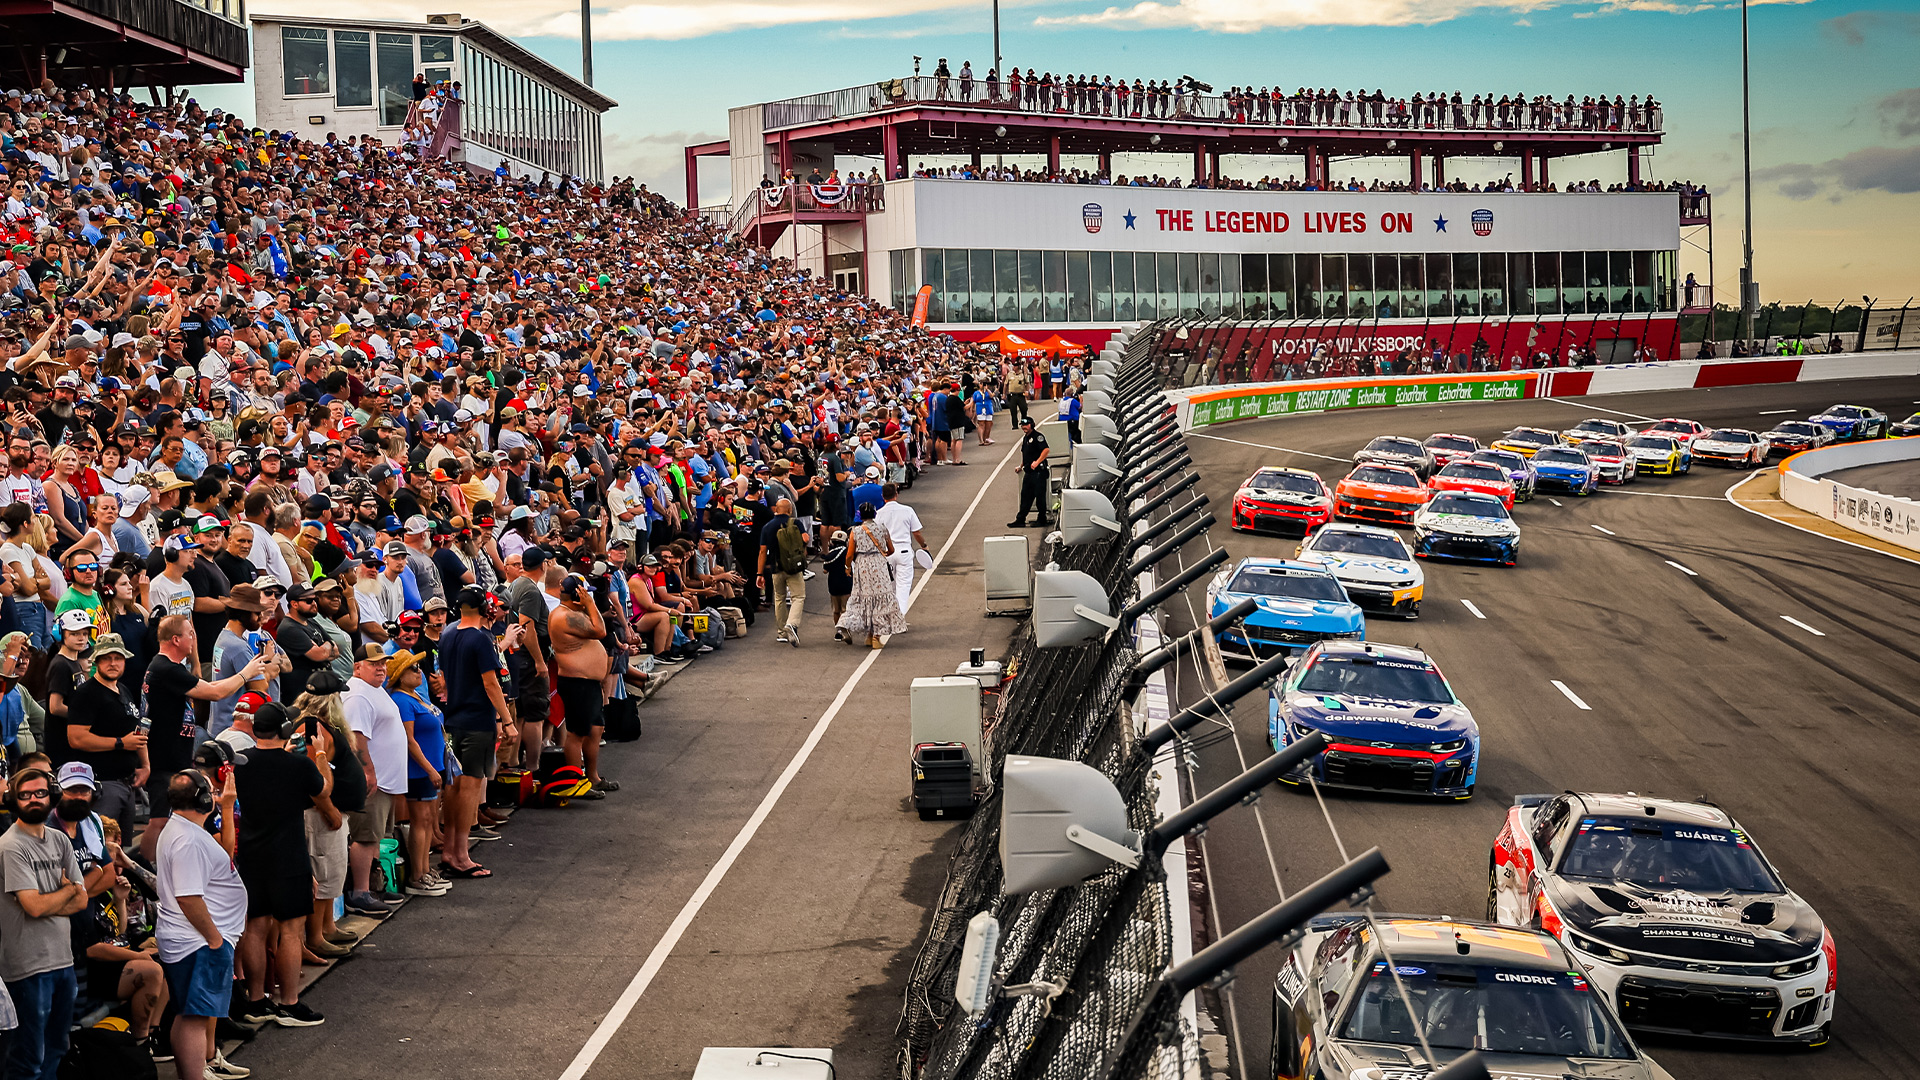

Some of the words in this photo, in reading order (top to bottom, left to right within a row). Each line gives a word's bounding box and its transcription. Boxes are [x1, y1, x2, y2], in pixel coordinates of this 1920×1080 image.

[1156, 209, 1193, 231] THE
[1206, 210, 1290, 233] LEGEND
[1304, 211, 1367, 233] LIVES
[1381, 212, 1413, 233] ON
[1295, 390, 1330, 410] RESTART
[1329, 388, 1353, 408] ZONE
[1356, 386, 1387, 406] EchoPark
[1395, 384, 1428, 404] EchoPark
[1437, 382, 1473, 402] EchoPark
[1483, 381, 1519, 399] EchoPark
[1376, 660, 1425, 671] MCDOWELL
[1324, 714, 1439, 731] delawarelife.com
[1674, 829, 1728, 843] SUÁREZ
[1658, 914, 1762, 932] ANNIVERSARY
[1642, 929, 1690, 937] CHANGE
[1691, 931, 1721, 939] KIDS'
[1724, 934, 1755, 945] LIVES
[1494, 972, 1557, 986] CINDRIC
